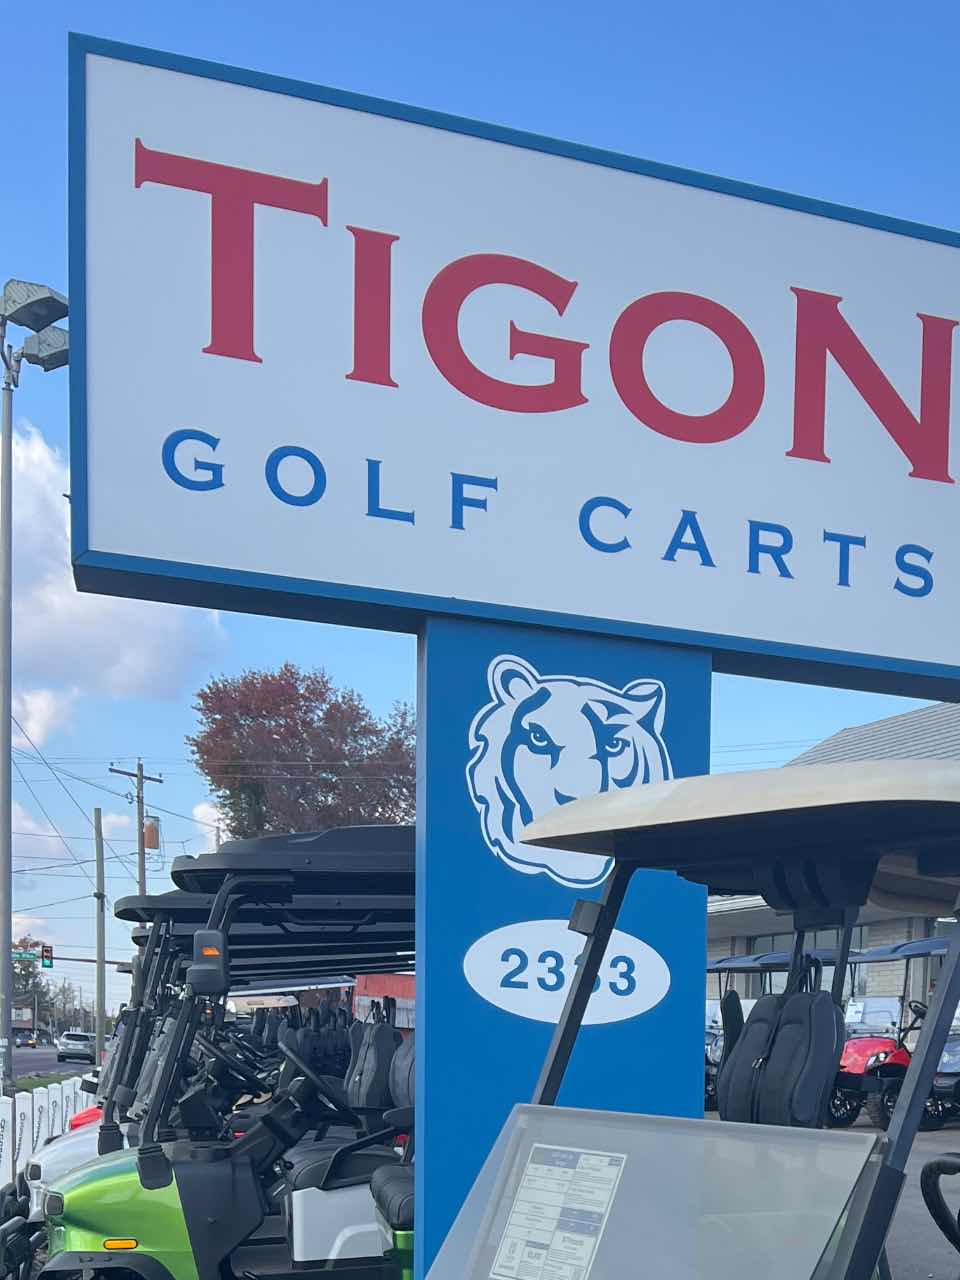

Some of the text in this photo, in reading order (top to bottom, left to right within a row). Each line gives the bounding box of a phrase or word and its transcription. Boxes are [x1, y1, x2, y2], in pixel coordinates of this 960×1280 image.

[135, 138, 957, 484] TIGON
[160, 428, 935, 600] GOLF CARTS
